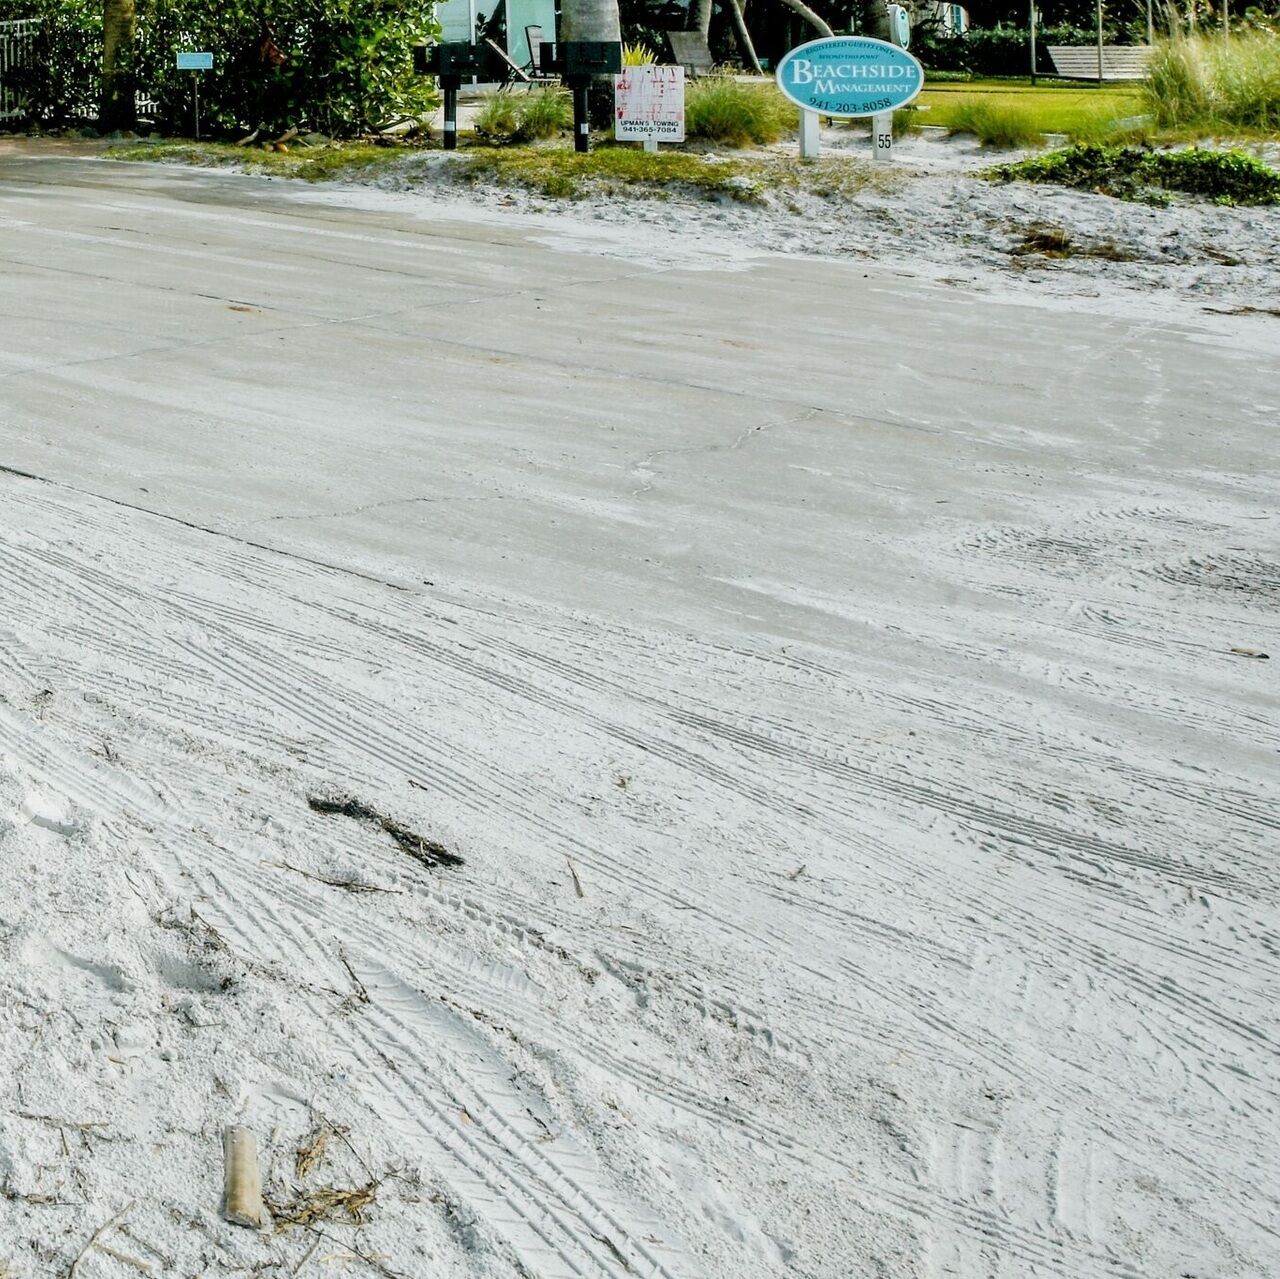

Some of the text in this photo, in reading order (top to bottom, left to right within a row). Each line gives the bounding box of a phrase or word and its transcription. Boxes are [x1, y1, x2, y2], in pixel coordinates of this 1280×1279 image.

[790, 59, 916, 84] BEACHSIDE
[814, 80, 911, 95] MANAGEMENT
[810, 97, 892, 113] 941-203-8058
[878, 134, 891, 149] 55
